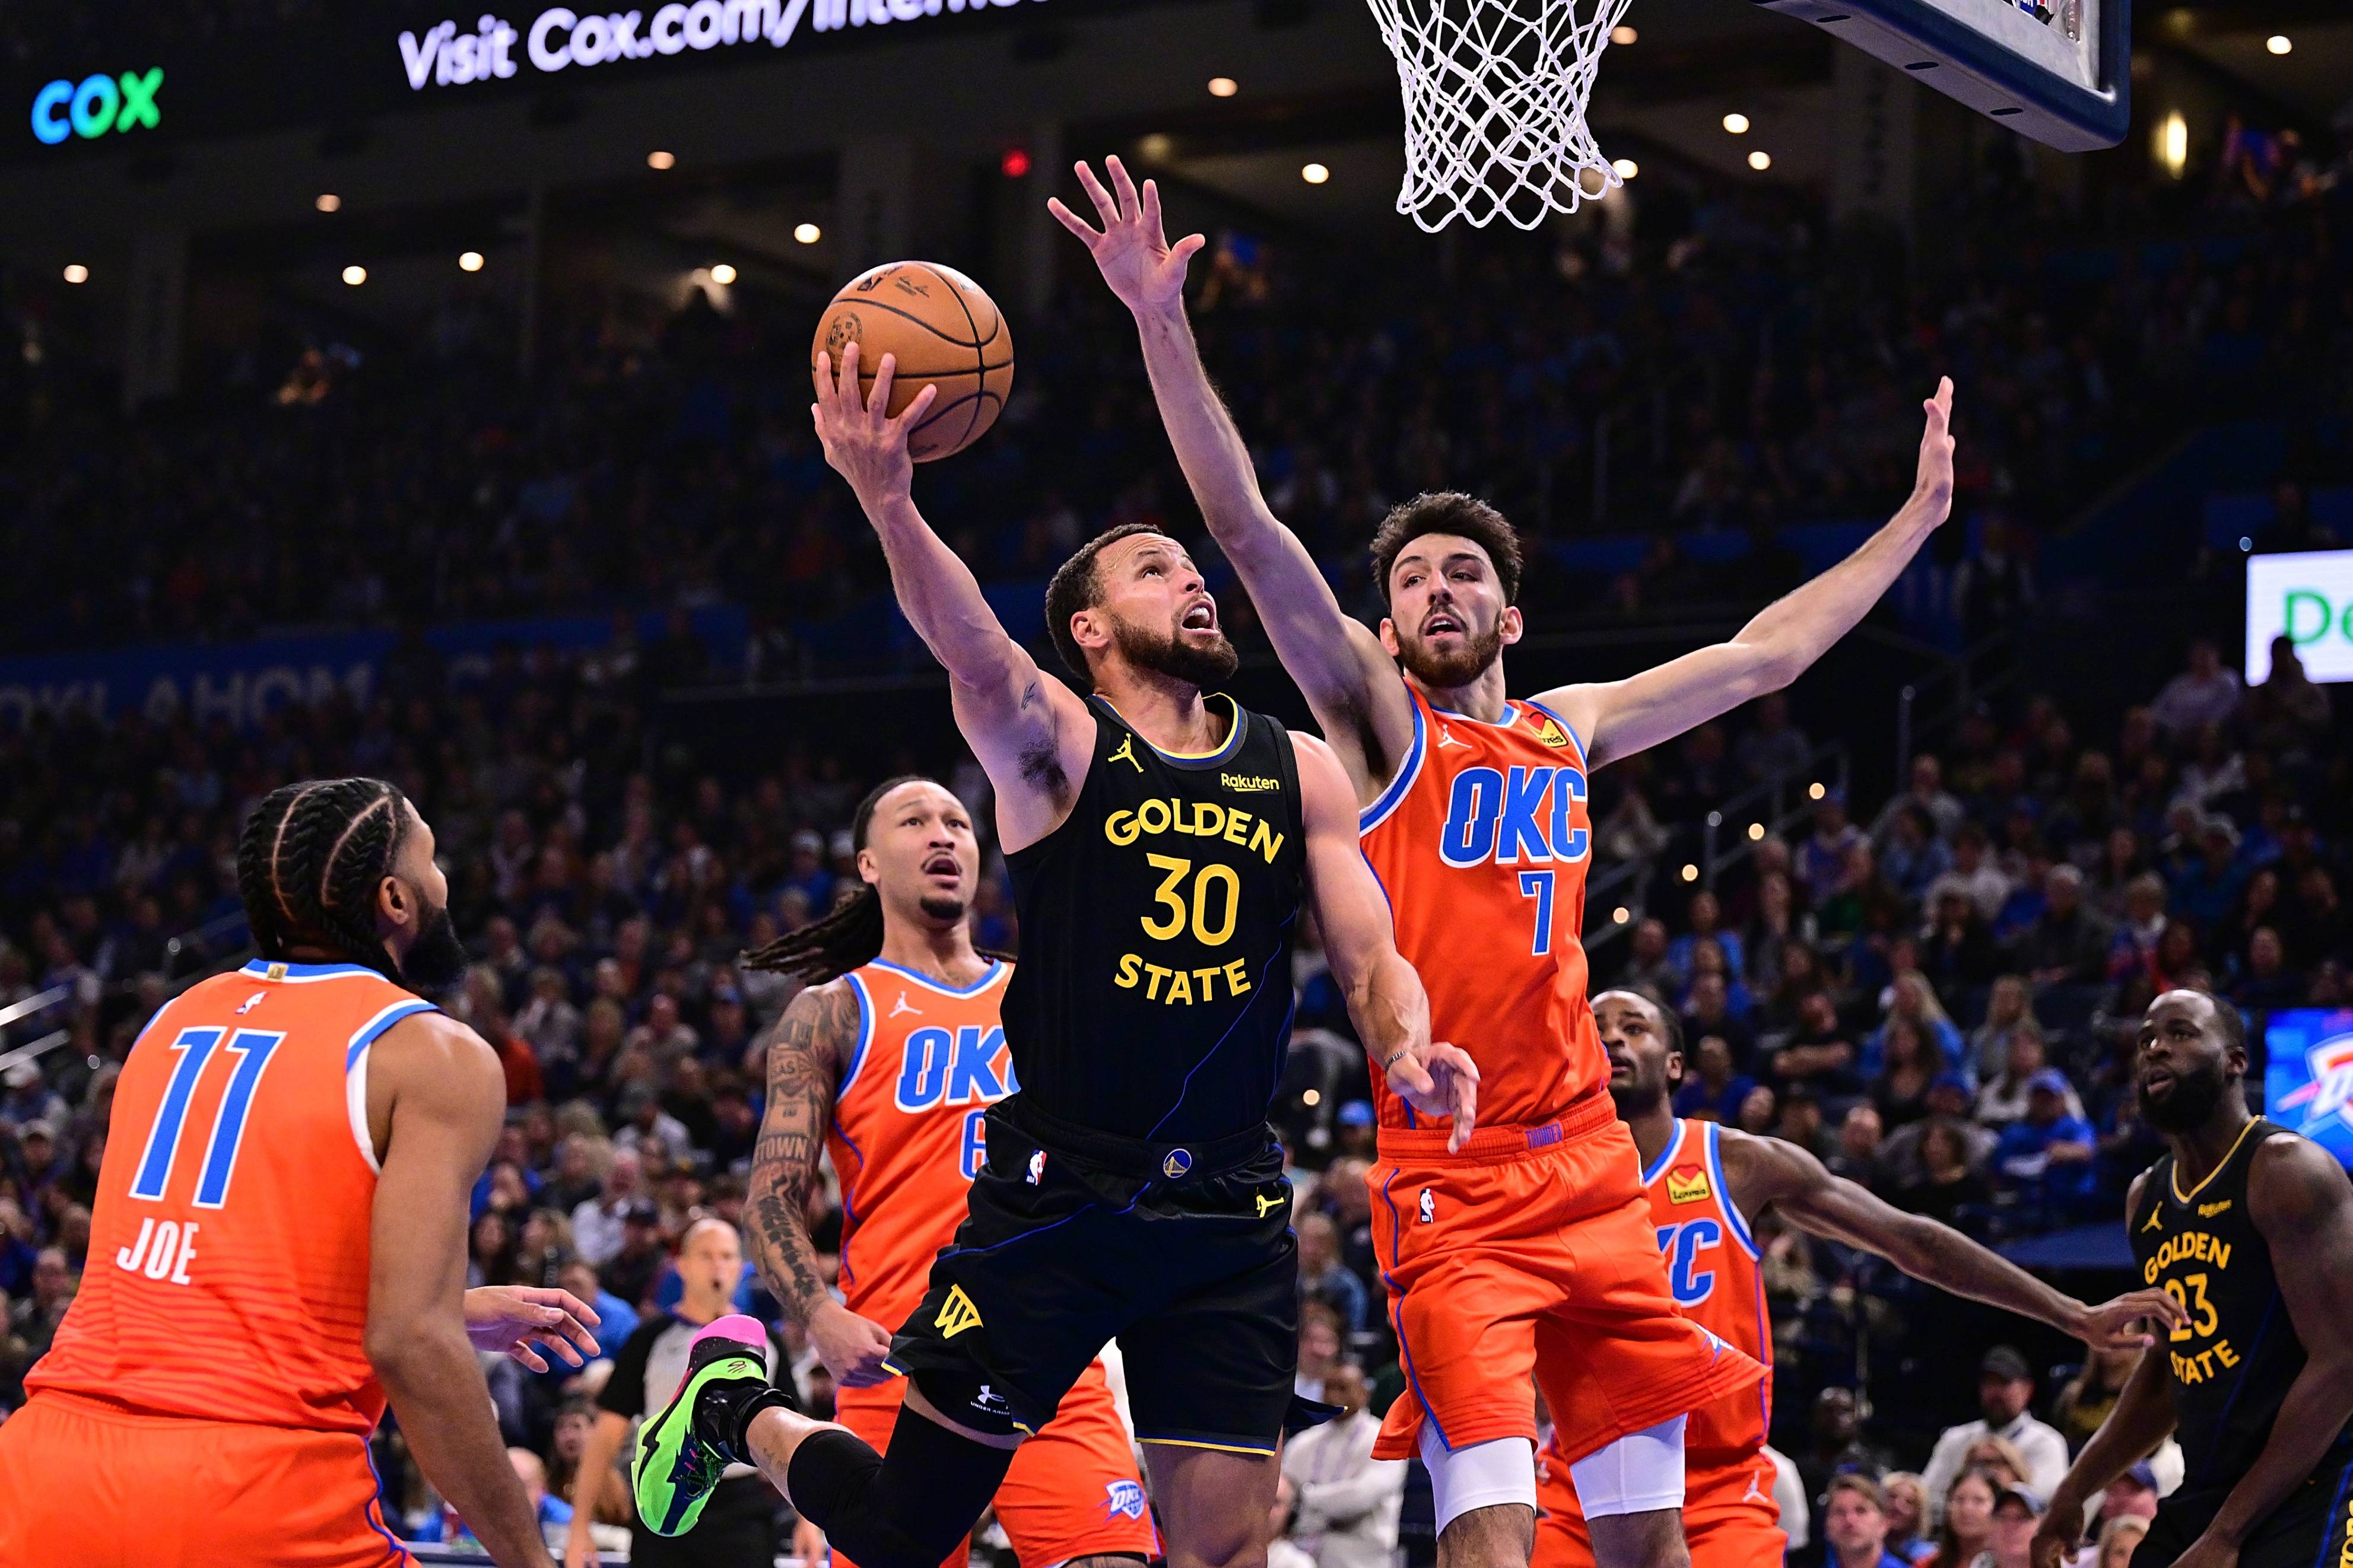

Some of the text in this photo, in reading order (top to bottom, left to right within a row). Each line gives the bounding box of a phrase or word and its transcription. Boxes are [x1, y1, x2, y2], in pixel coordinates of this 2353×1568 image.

[398, 13, 518, 90] Visit
[31, 66, 165, 144] COX
[2286, 590, 2353, 644] D
[1221, 773, 1279, 791] Rakuten
[1105, 798, 1284, 864] GOLDEN
[1439, 765, 1588, 869] OKC
[1141, 853, 1240, 946] 30
[1518, 870, 1555, 956] 7
[1114, 954, 1251, 1005] STATE
[128, 1026, 288, 1210] 11
[116, 1218, 200, 1286] JOE
[2144, 1230, 2231, 1285] GOLDEN
[2164, 1273, 2218, 1342] 23
